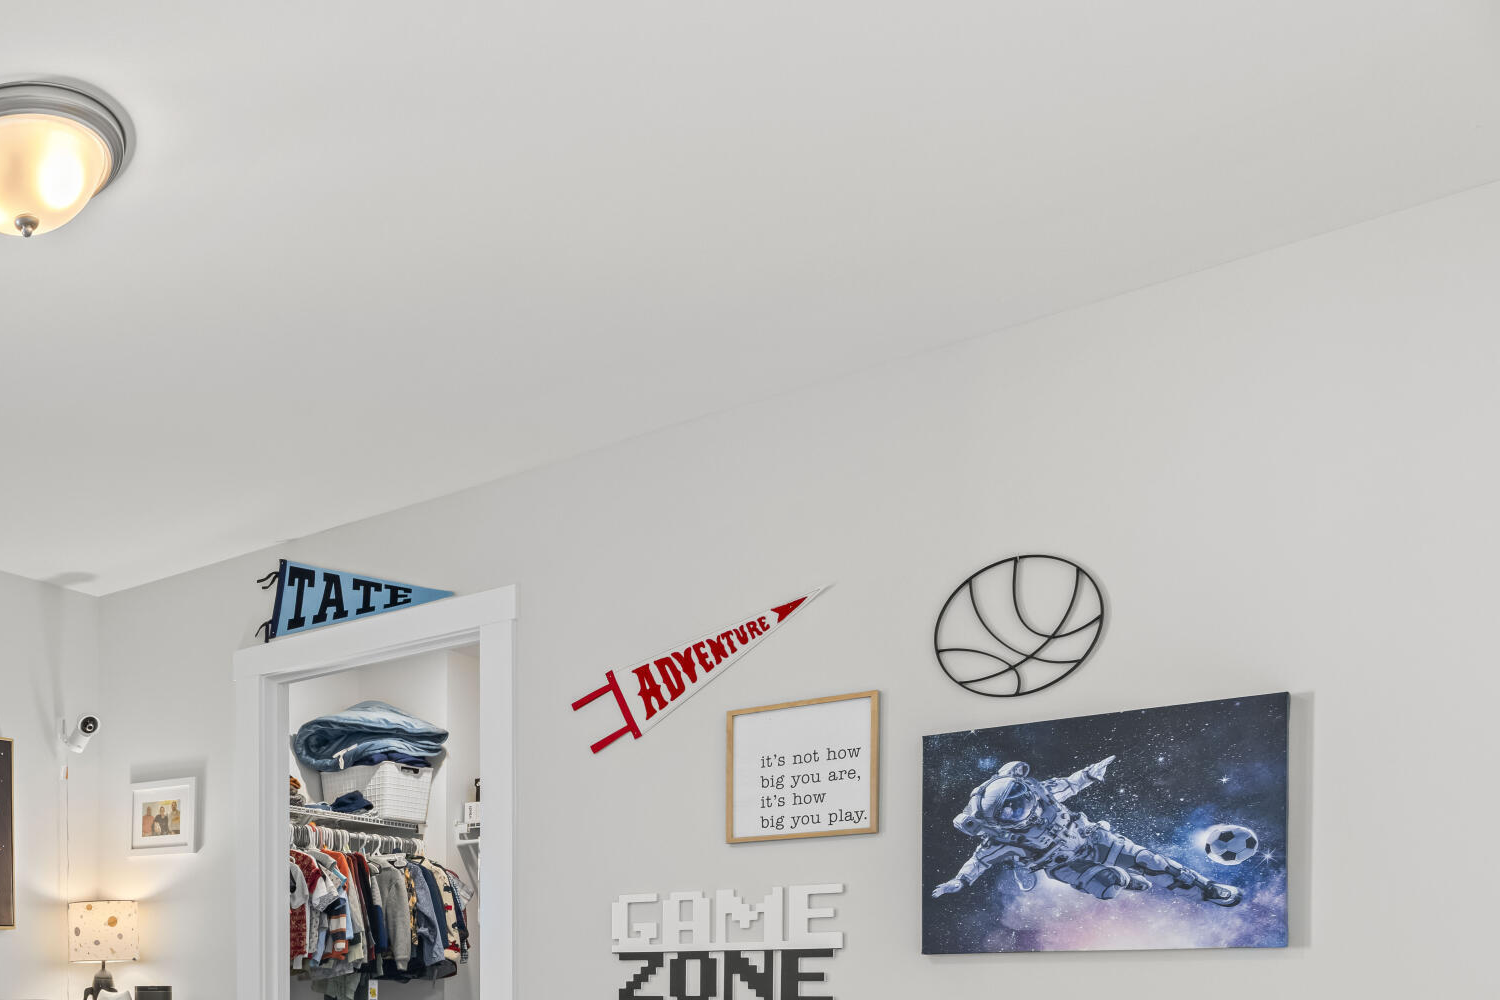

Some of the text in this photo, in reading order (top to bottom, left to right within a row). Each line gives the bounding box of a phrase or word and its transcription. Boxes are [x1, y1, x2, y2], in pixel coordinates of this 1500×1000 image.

[287, 565, 412, 630] TATE
[631, 615, 771, 720] ADVENTURE
[760, 746, 861, 768] it's not how
[760, 768, 861, 790] big you are,
[760, 792, 827, 809] it's how
[760, 808, 868, 831] big you play.
[611, 883, 844, 954] GAME
